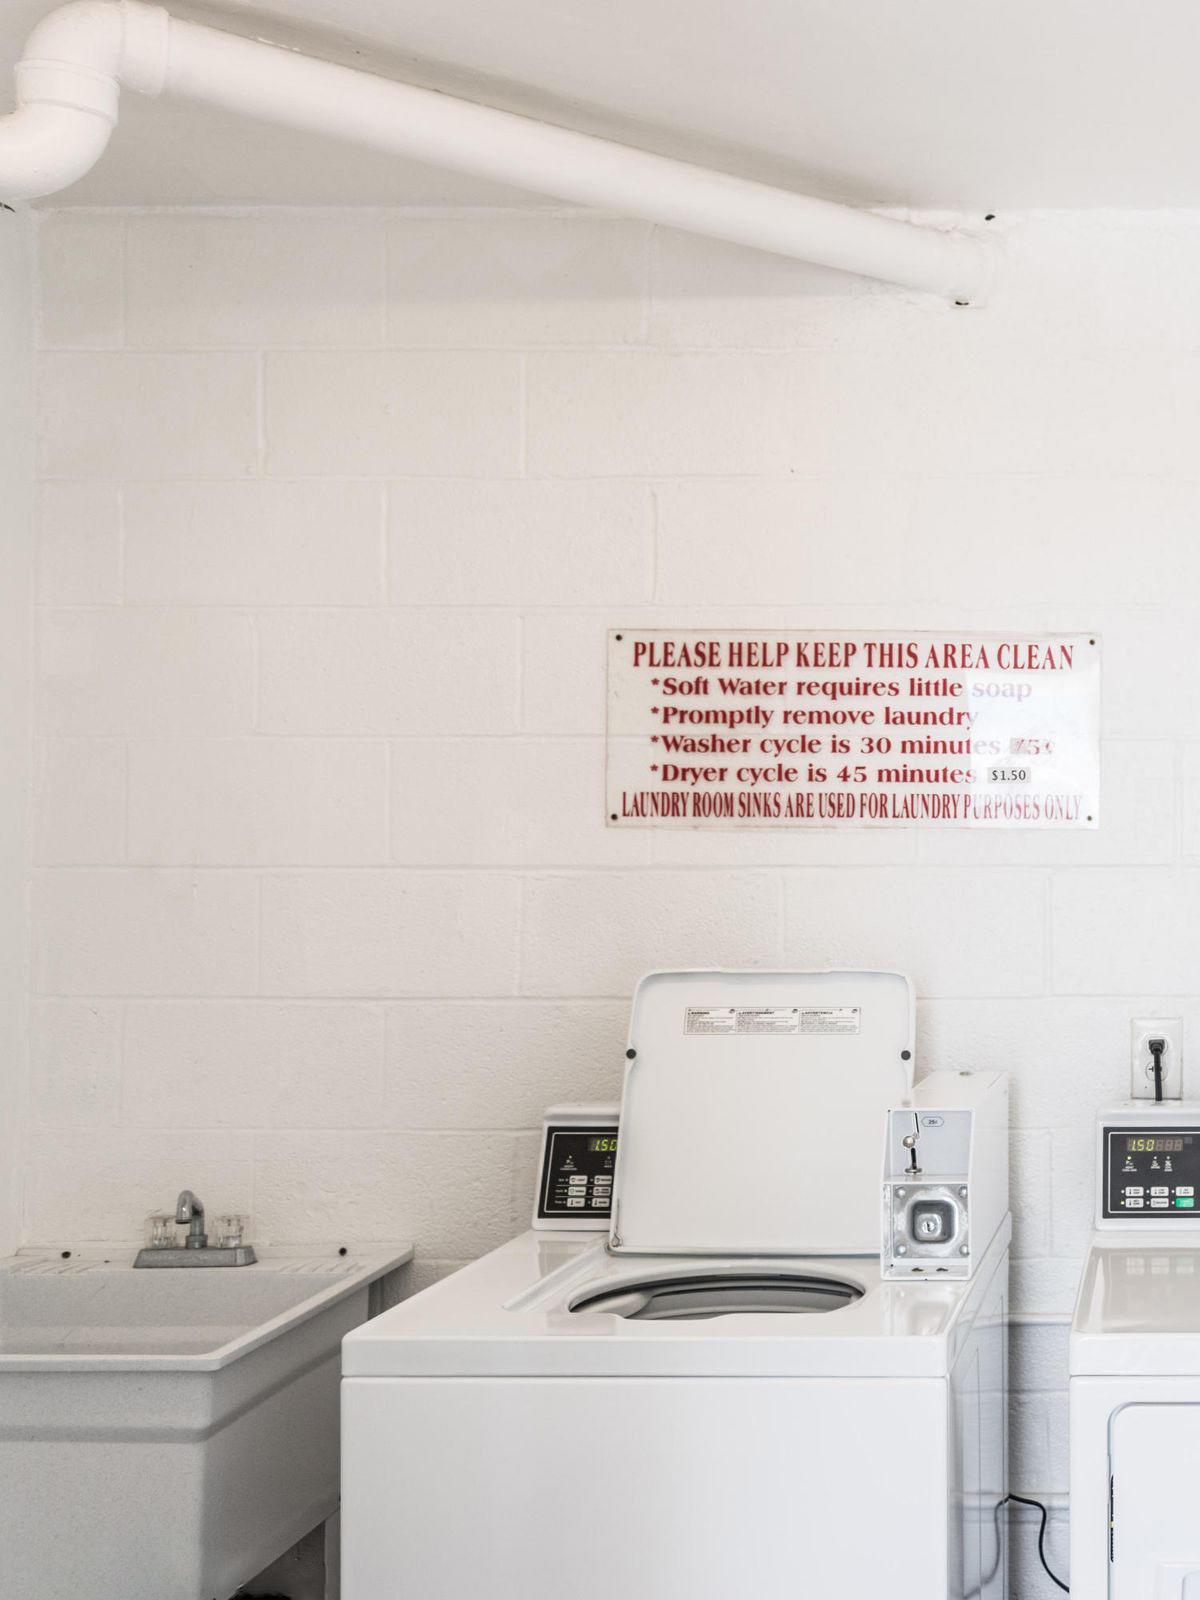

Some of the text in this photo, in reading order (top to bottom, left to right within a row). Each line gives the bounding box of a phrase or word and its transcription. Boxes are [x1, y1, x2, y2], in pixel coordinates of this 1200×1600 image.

[633, 641, 1075, 670] PLEASE HELP KEEP THIS AREA CLEAN
[717, 677, 788, 697] Water
[795, 677, 900, 701] requires
[908, 677, 963, 697] little
[971, 681, 1032, 702] soap
[782, 709, 875, 725] remove
[883, 706, 979, 731] laundry
[759, 734, 822, 758] cycle
[830, 734, 851, 754] is
[860, 737, 892, 755] 30
[900, 735, 1001, 755] minutes
[736, 763, 799, 786] cycle
[806, 763, 828, 783] is
[836, 765, 868, 784] 45
[876, 764, 977, 784] minutes
[991, 769, 1027, 781] $1.50
[621, 791, 1083, 820] LAUNDRY ROOM SINKS ARE USED FOR LAUNDRY PURPOSES ONLY
